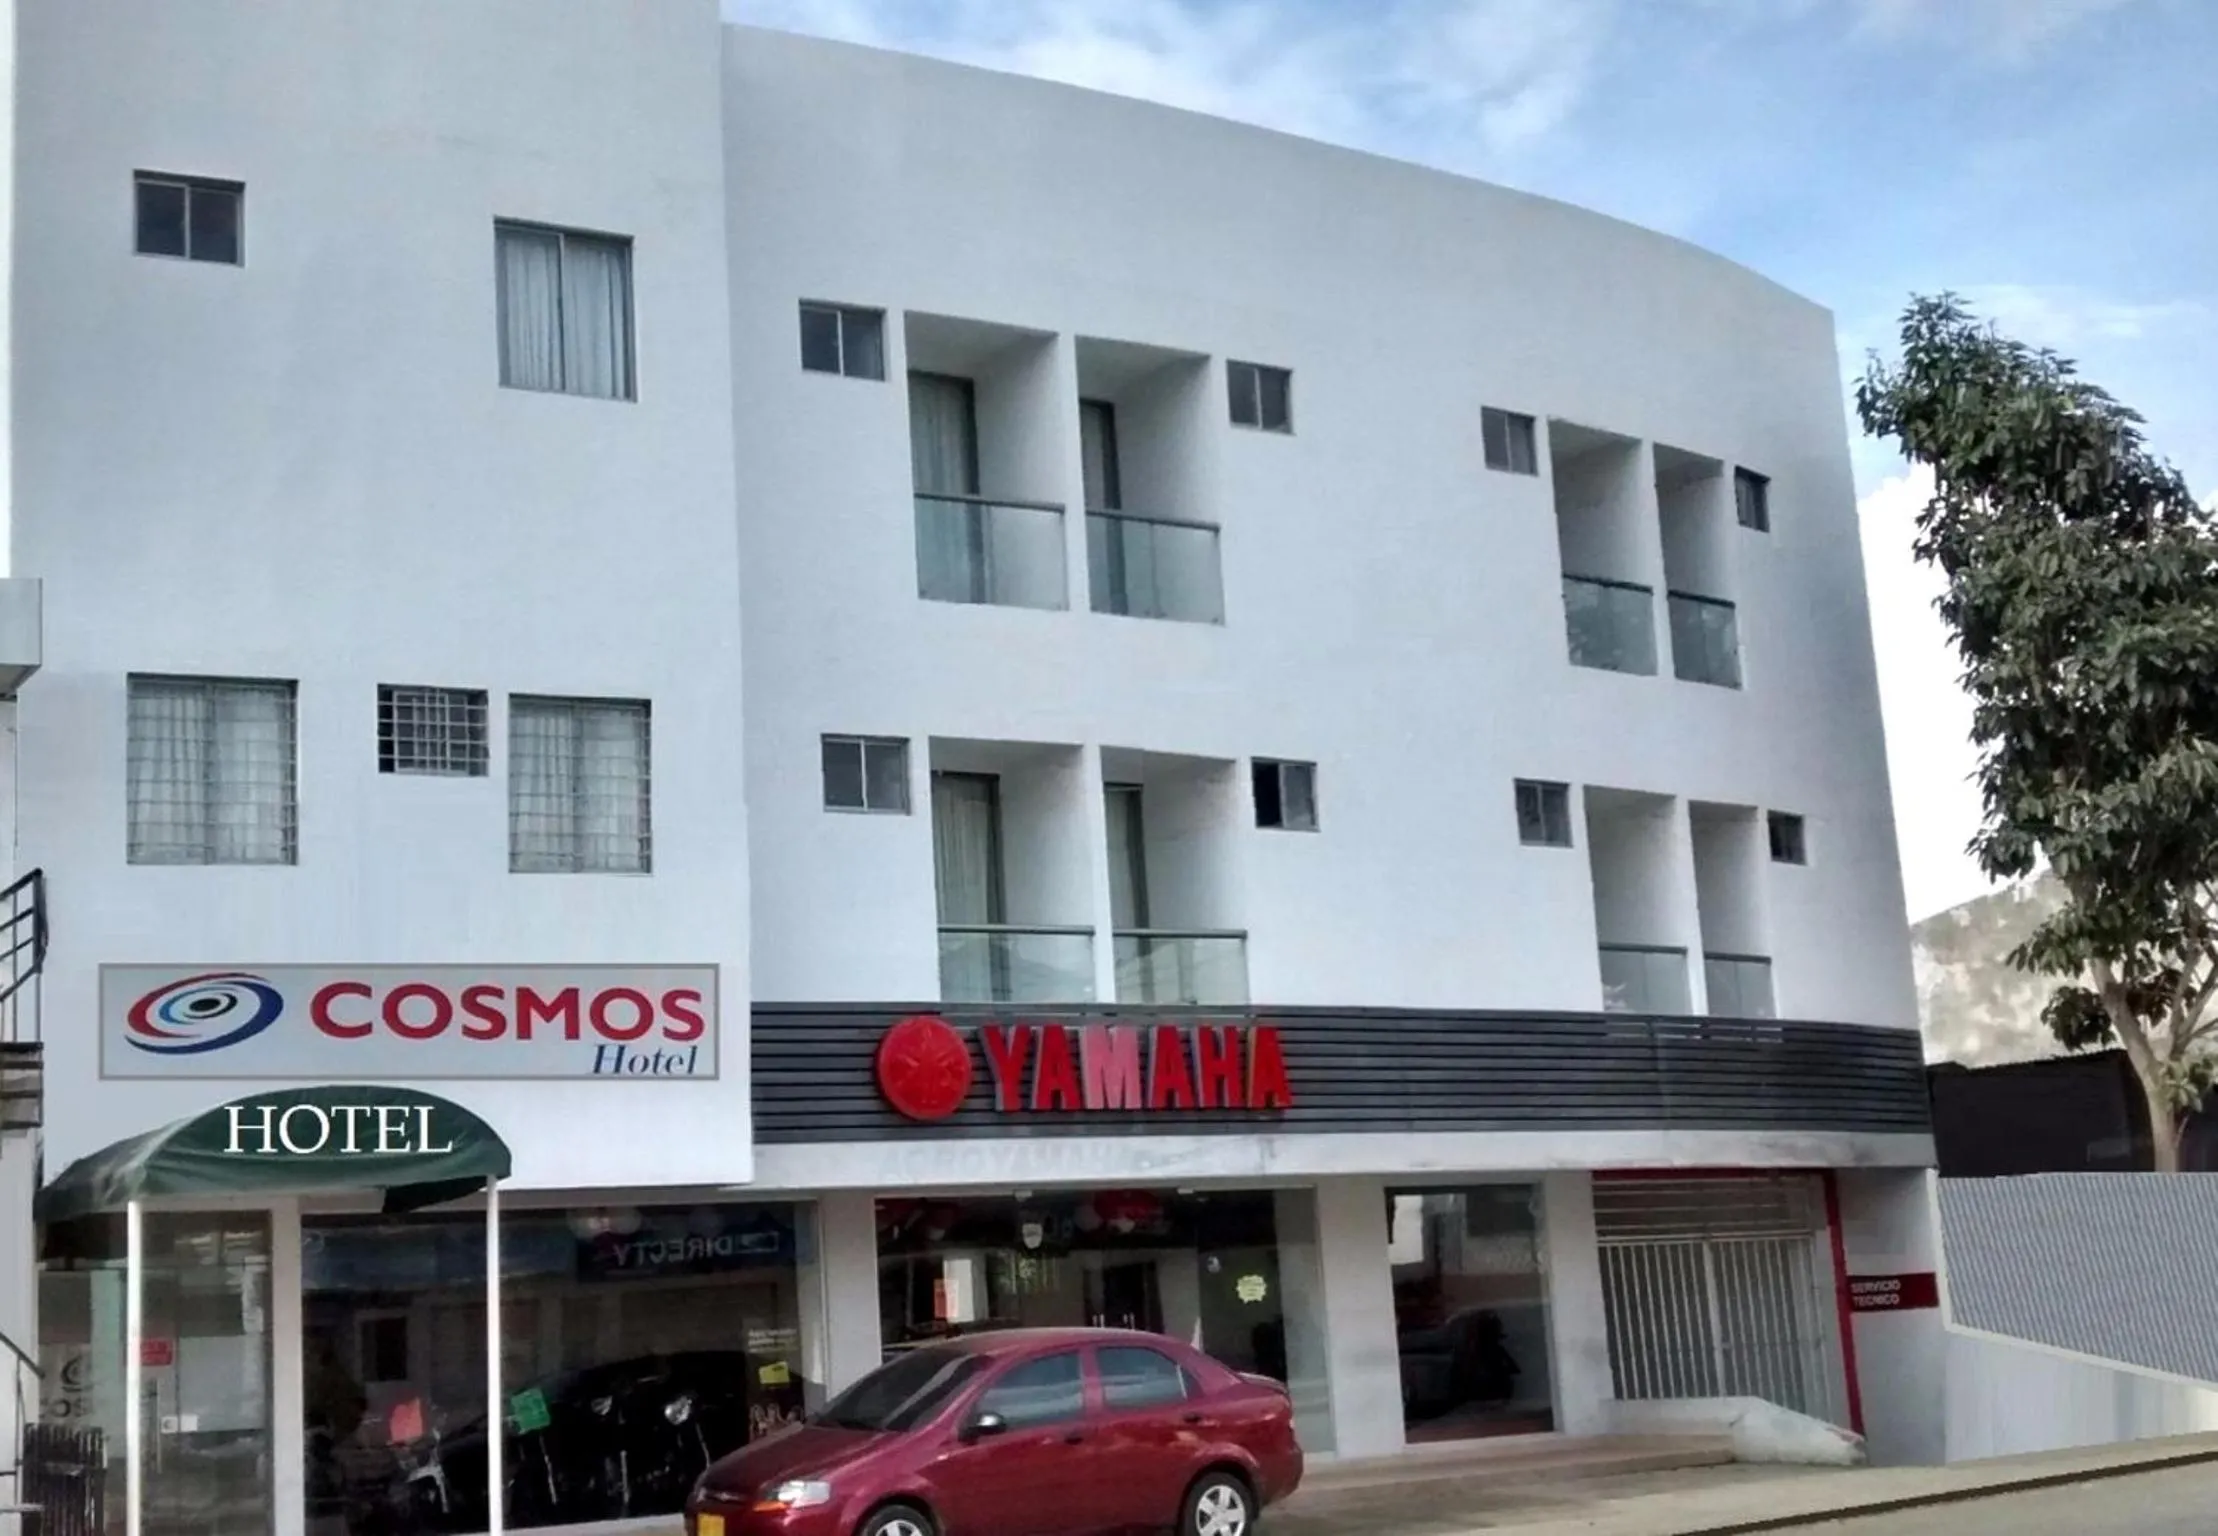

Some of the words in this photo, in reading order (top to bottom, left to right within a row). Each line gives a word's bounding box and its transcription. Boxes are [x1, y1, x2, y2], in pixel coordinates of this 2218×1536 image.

[310, 981, 705, 1041] COSMOS
[592, 1044, 698, 1075] Hotel
[980, 1024, 1292, 1111] YAMAHA
[224, 1104, 453, 1154] HOTEL
